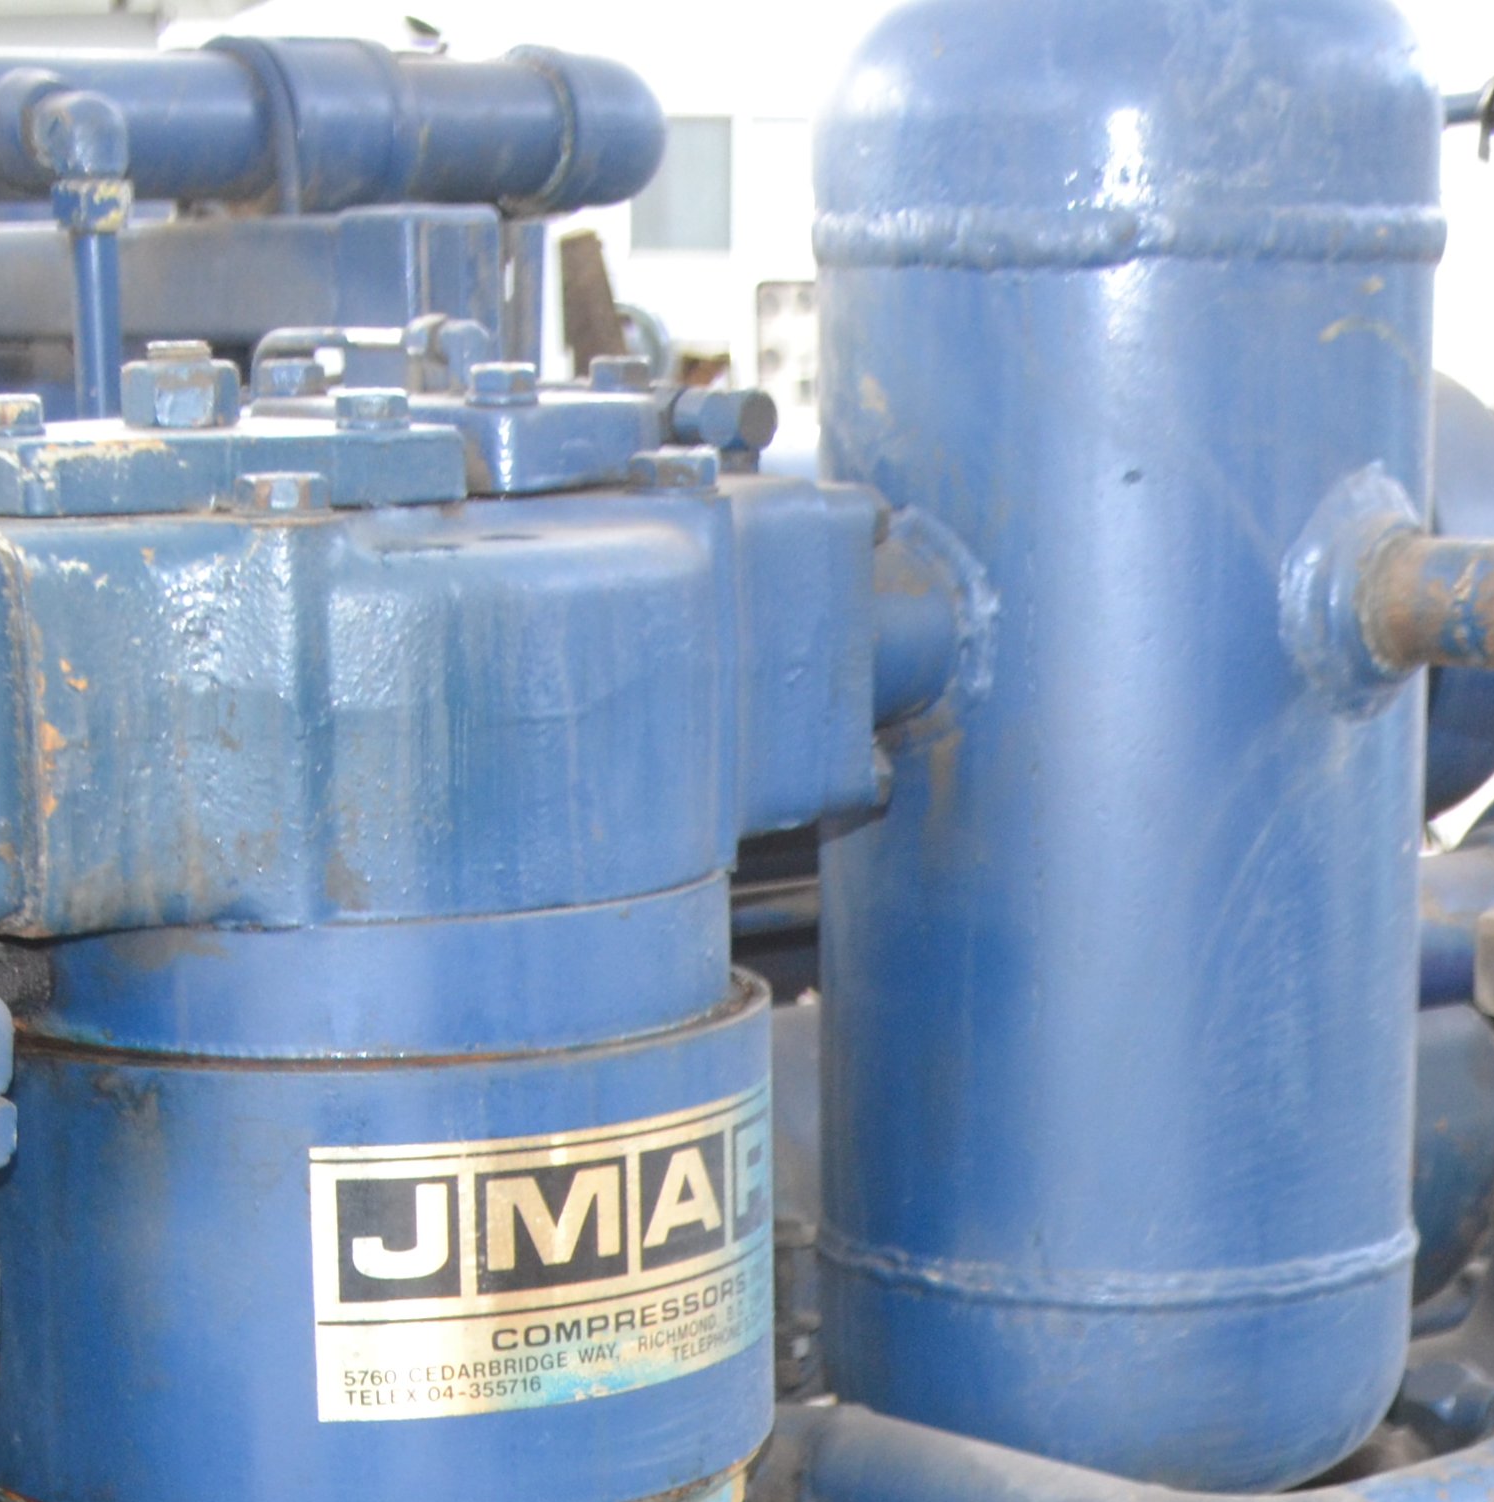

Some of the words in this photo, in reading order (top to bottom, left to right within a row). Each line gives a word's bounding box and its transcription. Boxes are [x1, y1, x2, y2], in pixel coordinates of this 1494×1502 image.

[492, 1272, 746, 1351] COMPRESSORS
[344, 1370, 397, 1387] 5760
[409, 1349, 568, 1383] CEDARBRIDGE
[428, 1375, 542, 1402] 04-355716
